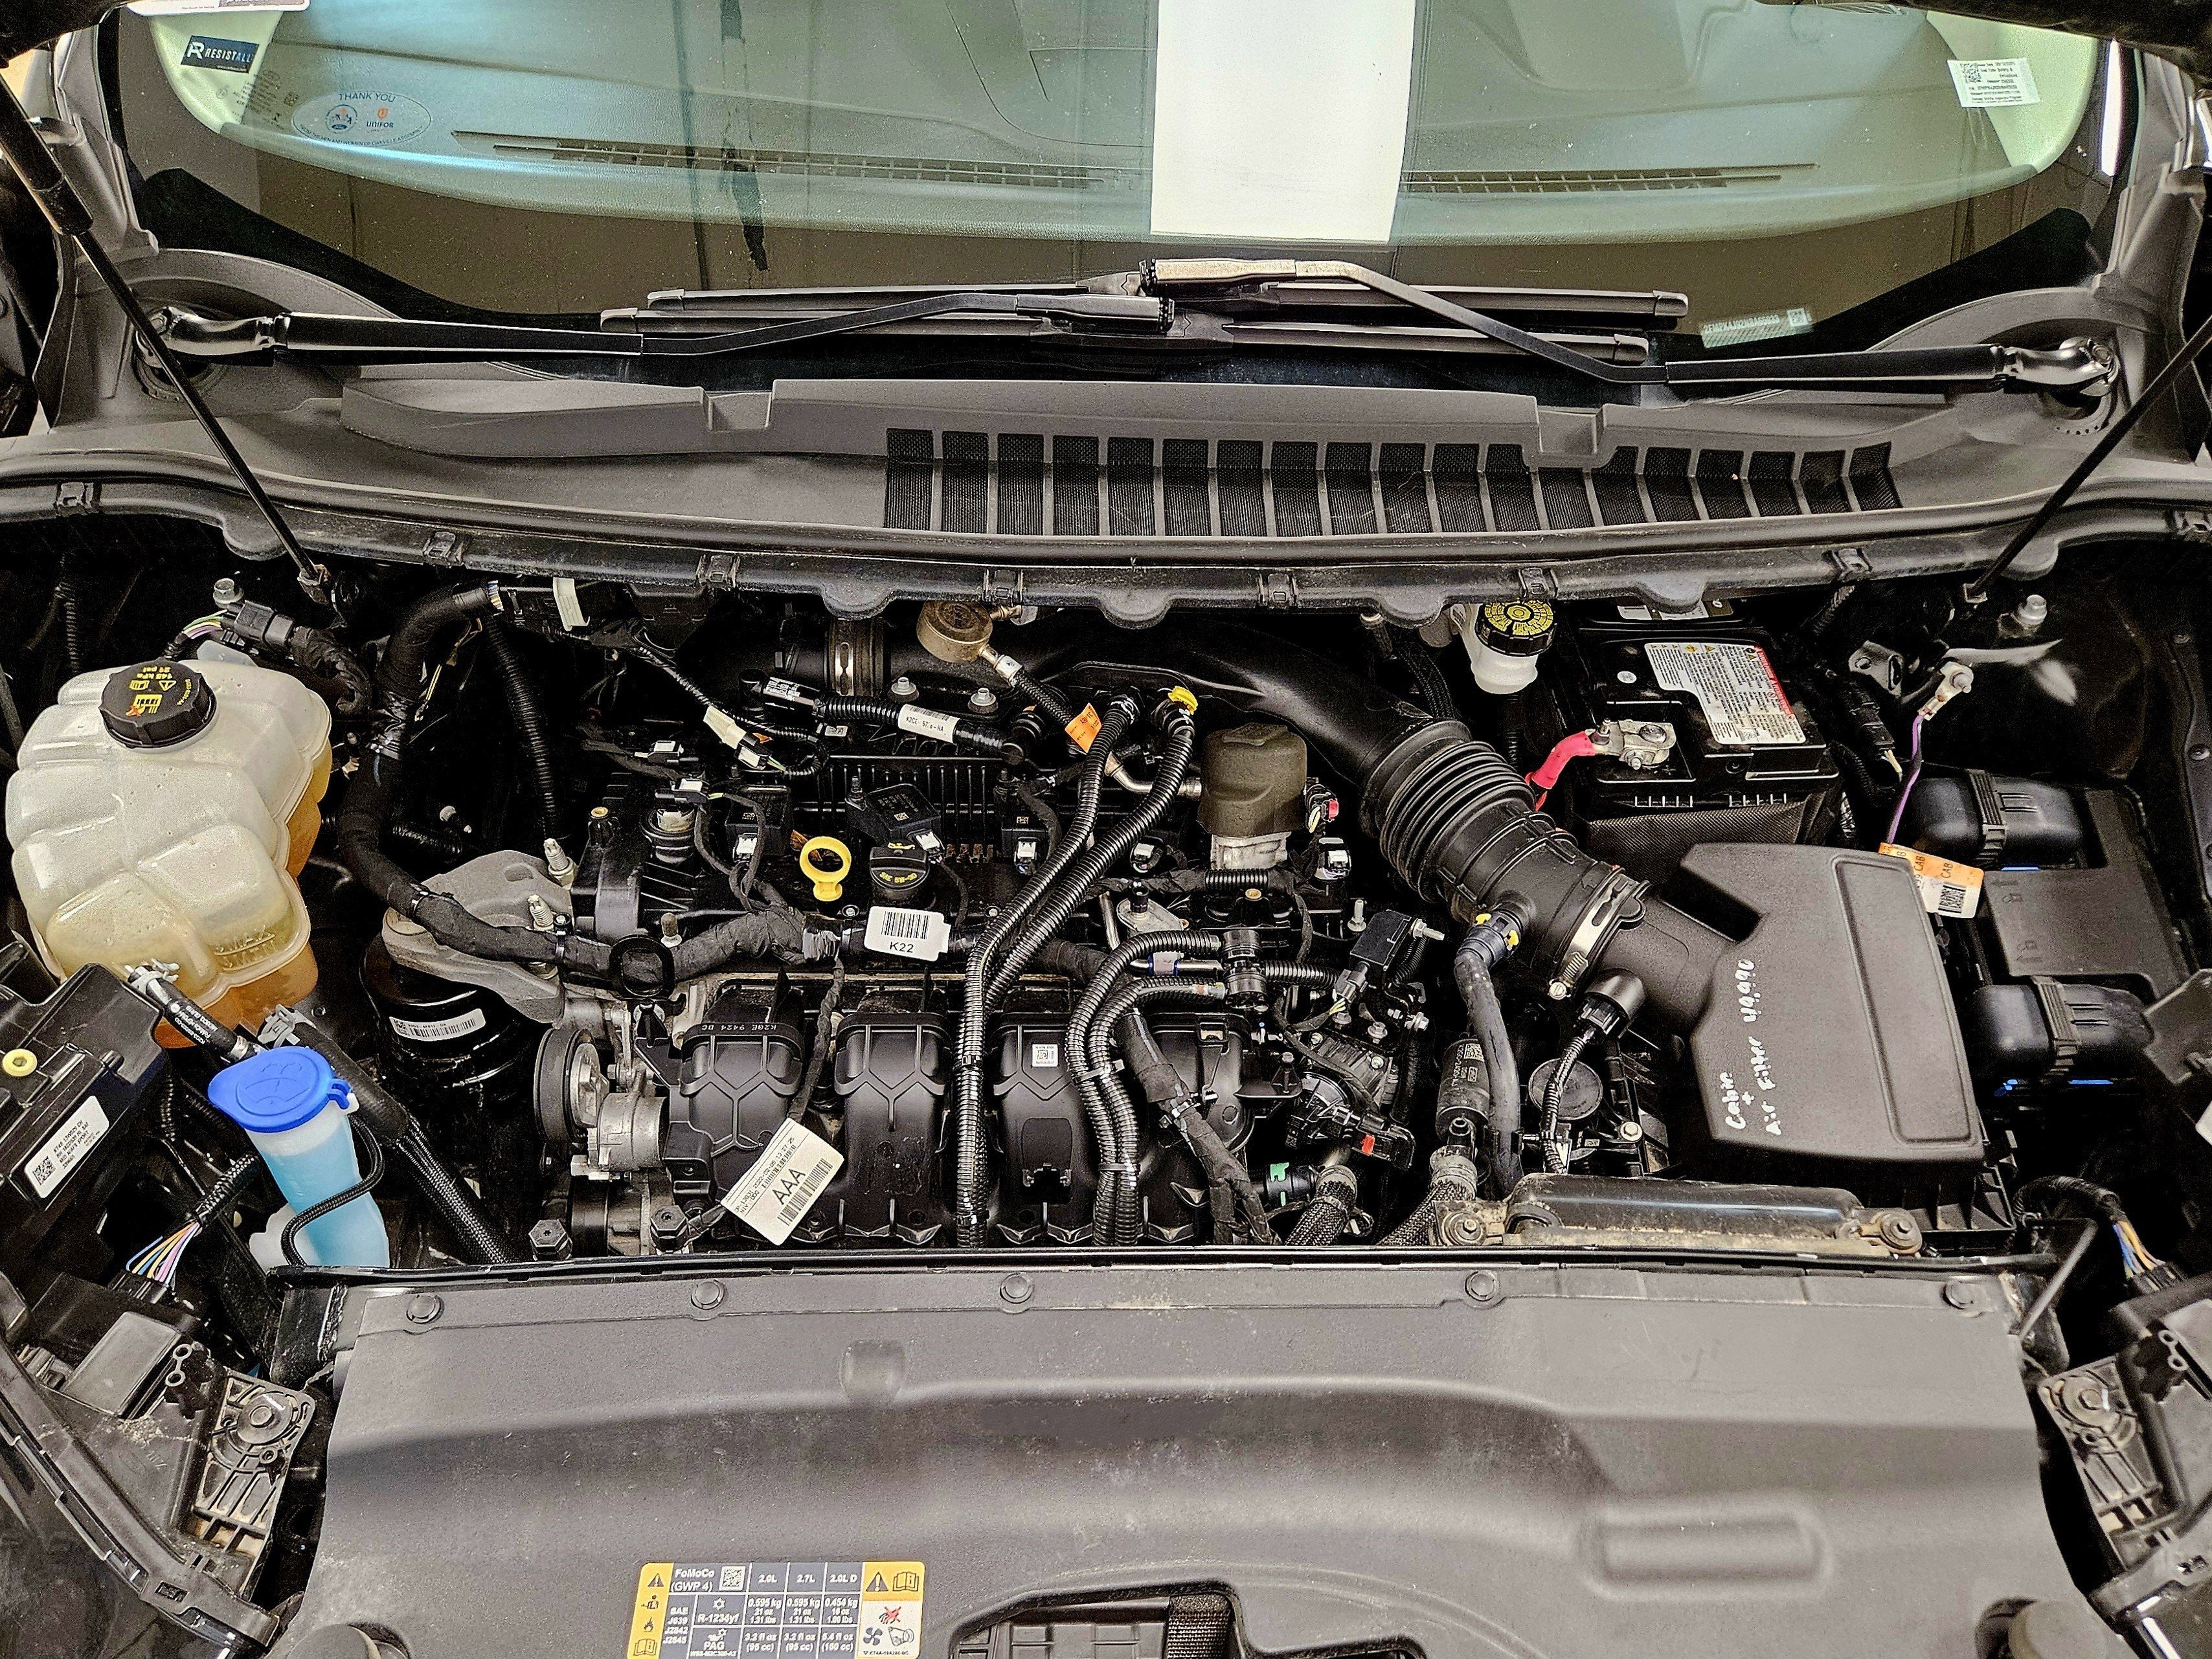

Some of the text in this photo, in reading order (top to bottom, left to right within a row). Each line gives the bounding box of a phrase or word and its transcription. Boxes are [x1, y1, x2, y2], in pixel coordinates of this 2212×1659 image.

[205, 47, 251, 63] RESISTALL
[339, 91, 396, 103] THANK YOU
[1913, 855, 1926, 872] CAB
[1941, 862, 1954, 879] CAB
[879, 872, 893, 882] SAE
[889, 941, 914, 953] K22
[1748, 1036, 1782, 1136] Air Filter
[1719, 1072, 1747, 1130] Cabin
[78, 1131, 89, 1145] SPORT
[772, 1169, 806, 1205] AAA
[675, 1568, 716, 1578] FoMoCo
[758, 1574, 778, 1583] 2.0L
[796, 1574, 817, 1583] 2.7L
[830, 1574, 858, 1583] 2.0L D
[701, 1581, 714, 1592] 4)
[771, 1598, 783, 1610] kg
[809, 1598, 822, 1610] kg
[824, 1597, 859, 1609] 0.454 kg
[670, 1607, 688, 1616] SAE
[668, 1616, 688, 1625] J639
[697, 1612, 740, 1625] R-1234yf
[764, 1616, 776, 1624] lbs
[803, 1616, 816, 1624] lbs
[841, 1616, 853, 1624] lbs
[744, 1632, 759, 1642] 3.2
[758, 1632, 766, 1642] fl
[784, 1632, 798, 1642] 3.2
[797, 1632, 805, 1642] fl
[822, 1632, 835, 1642] 5.4
[835, 1632, 842, 1642] fl
[703, 1641, 726, 1651] PAG
[746, 1643, 775, 1653] (95 cc)
[785, 1643, 815, 1653] (95 cc)
[821, 1643, 855, 1653] (160 cc)
